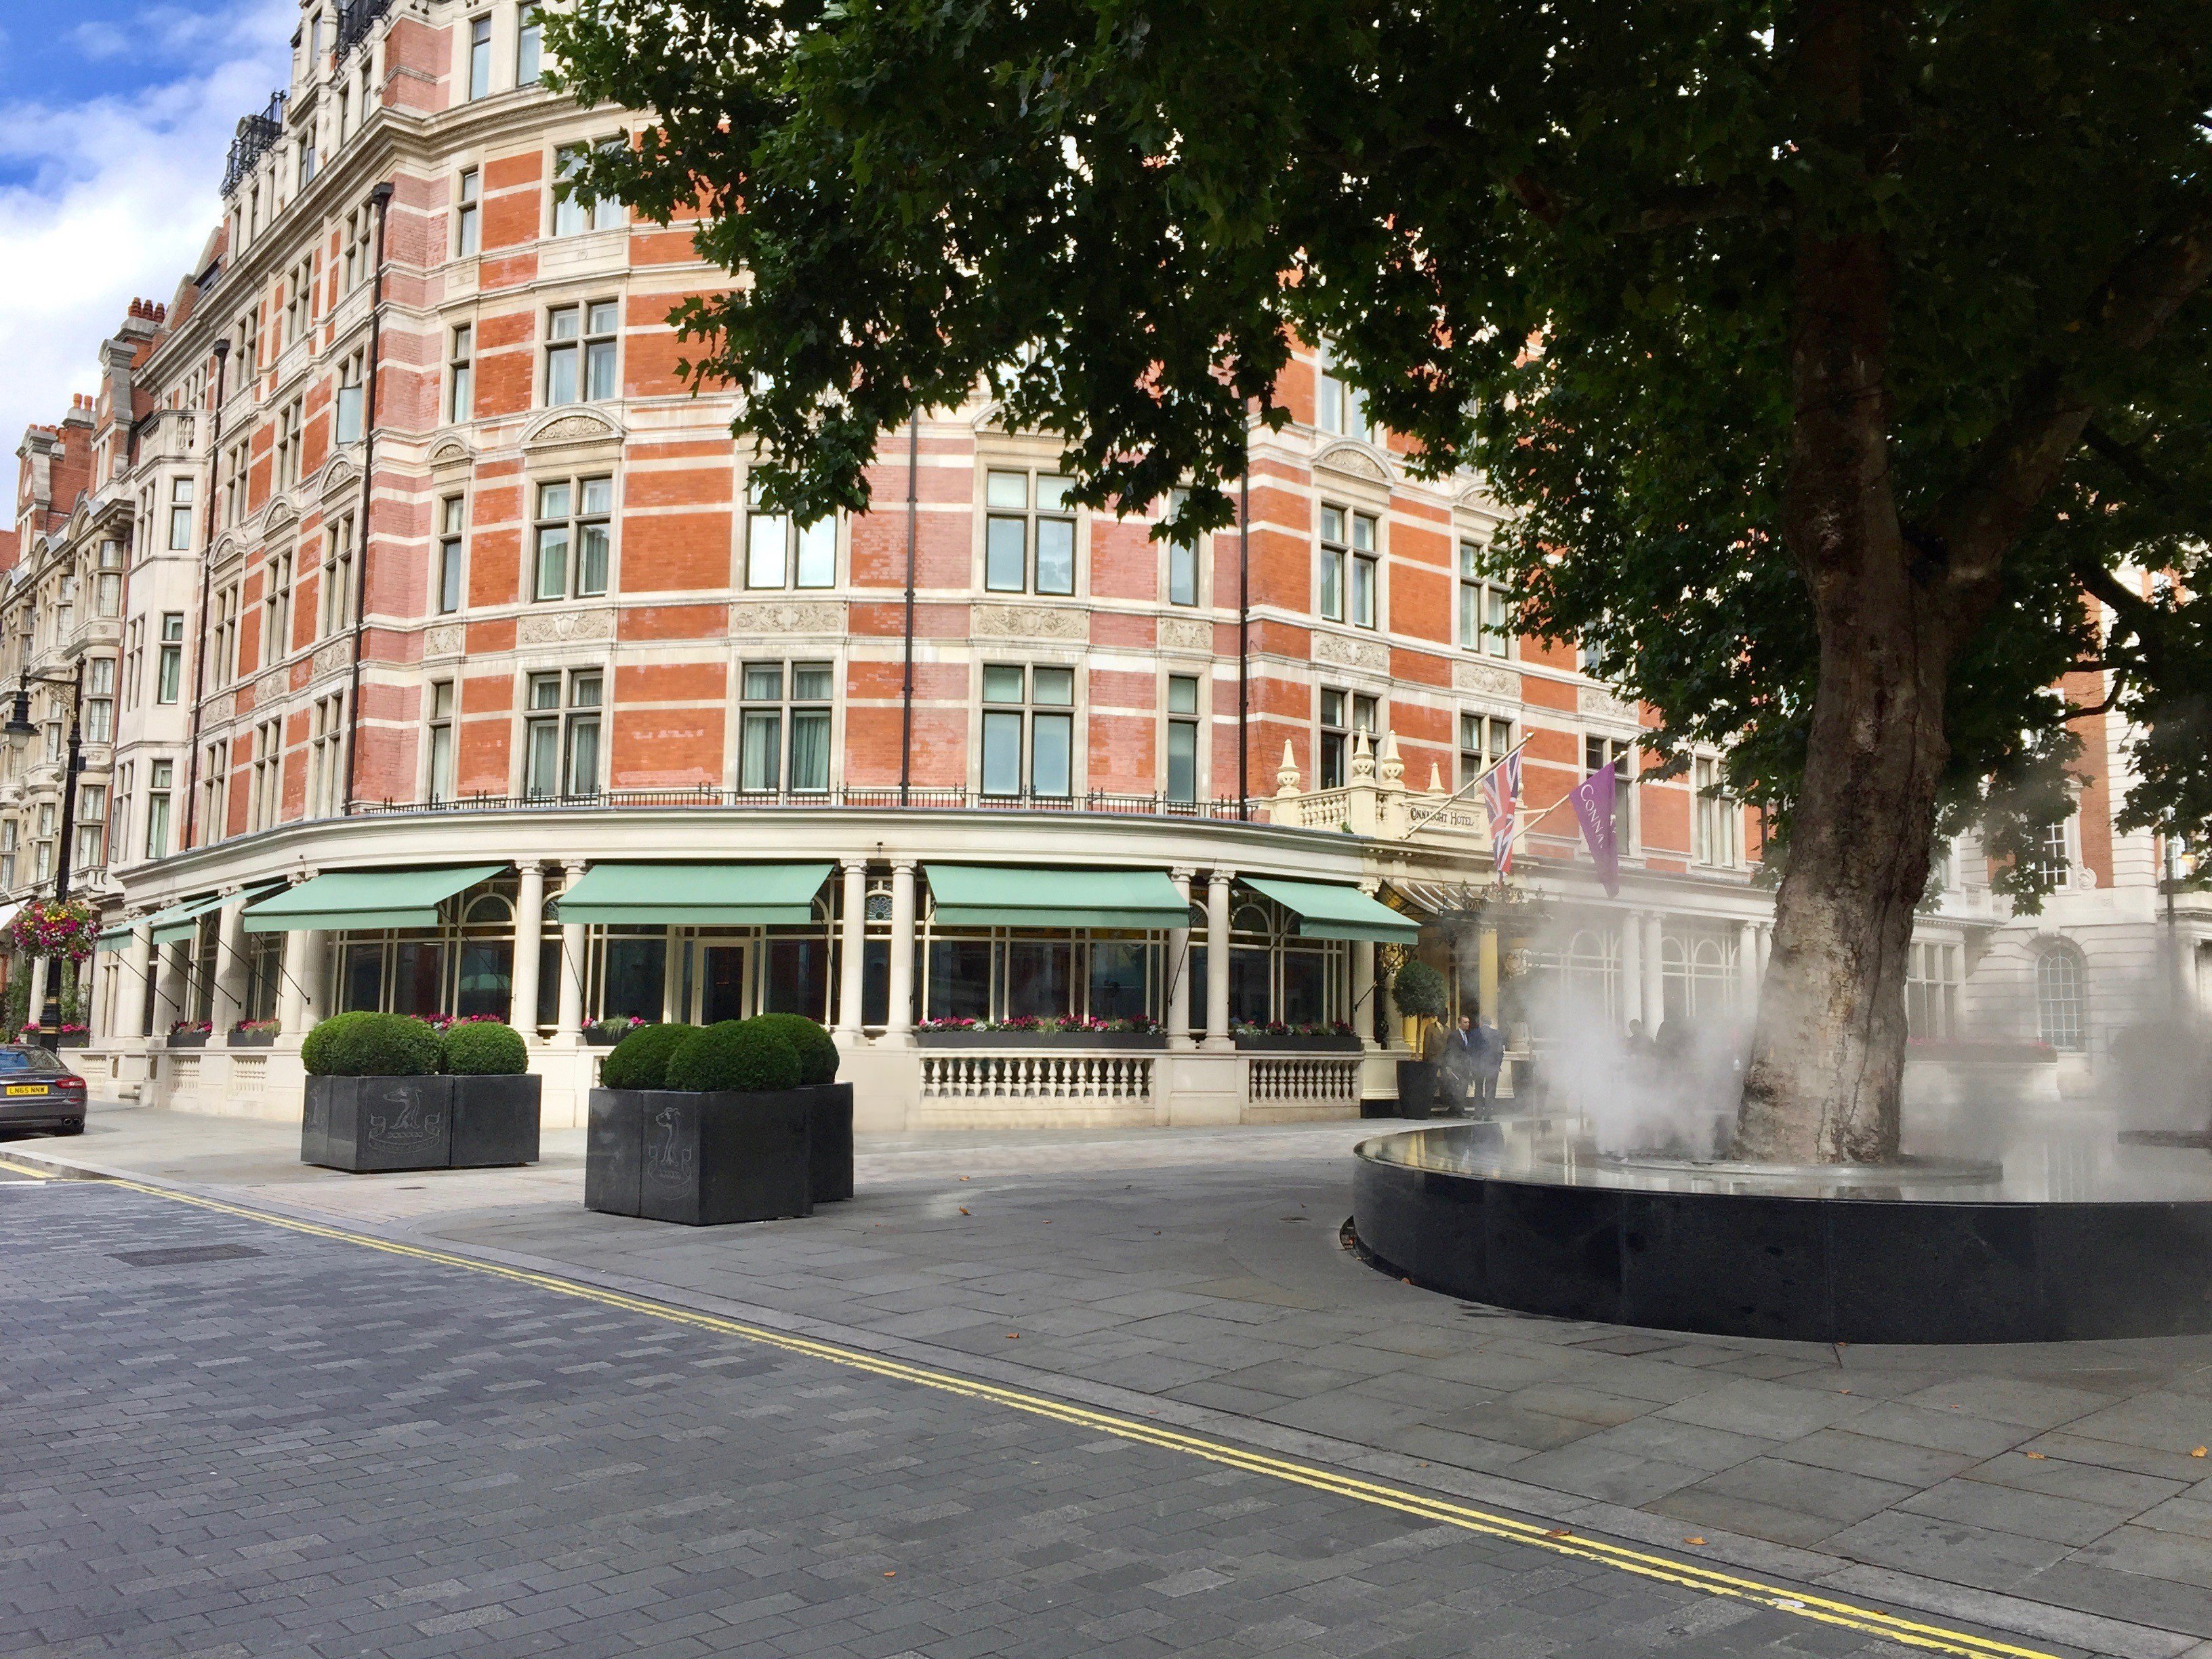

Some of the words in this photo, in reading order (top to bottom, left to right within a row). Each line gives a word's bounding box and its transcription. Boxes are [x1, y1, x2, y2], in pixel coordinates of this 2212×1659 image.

[1410, 807, 1448, 823] CONNGHT
[1450, 811, 1475, 826] HOTEL
[1580, 783, 1605, 848] CONNA
